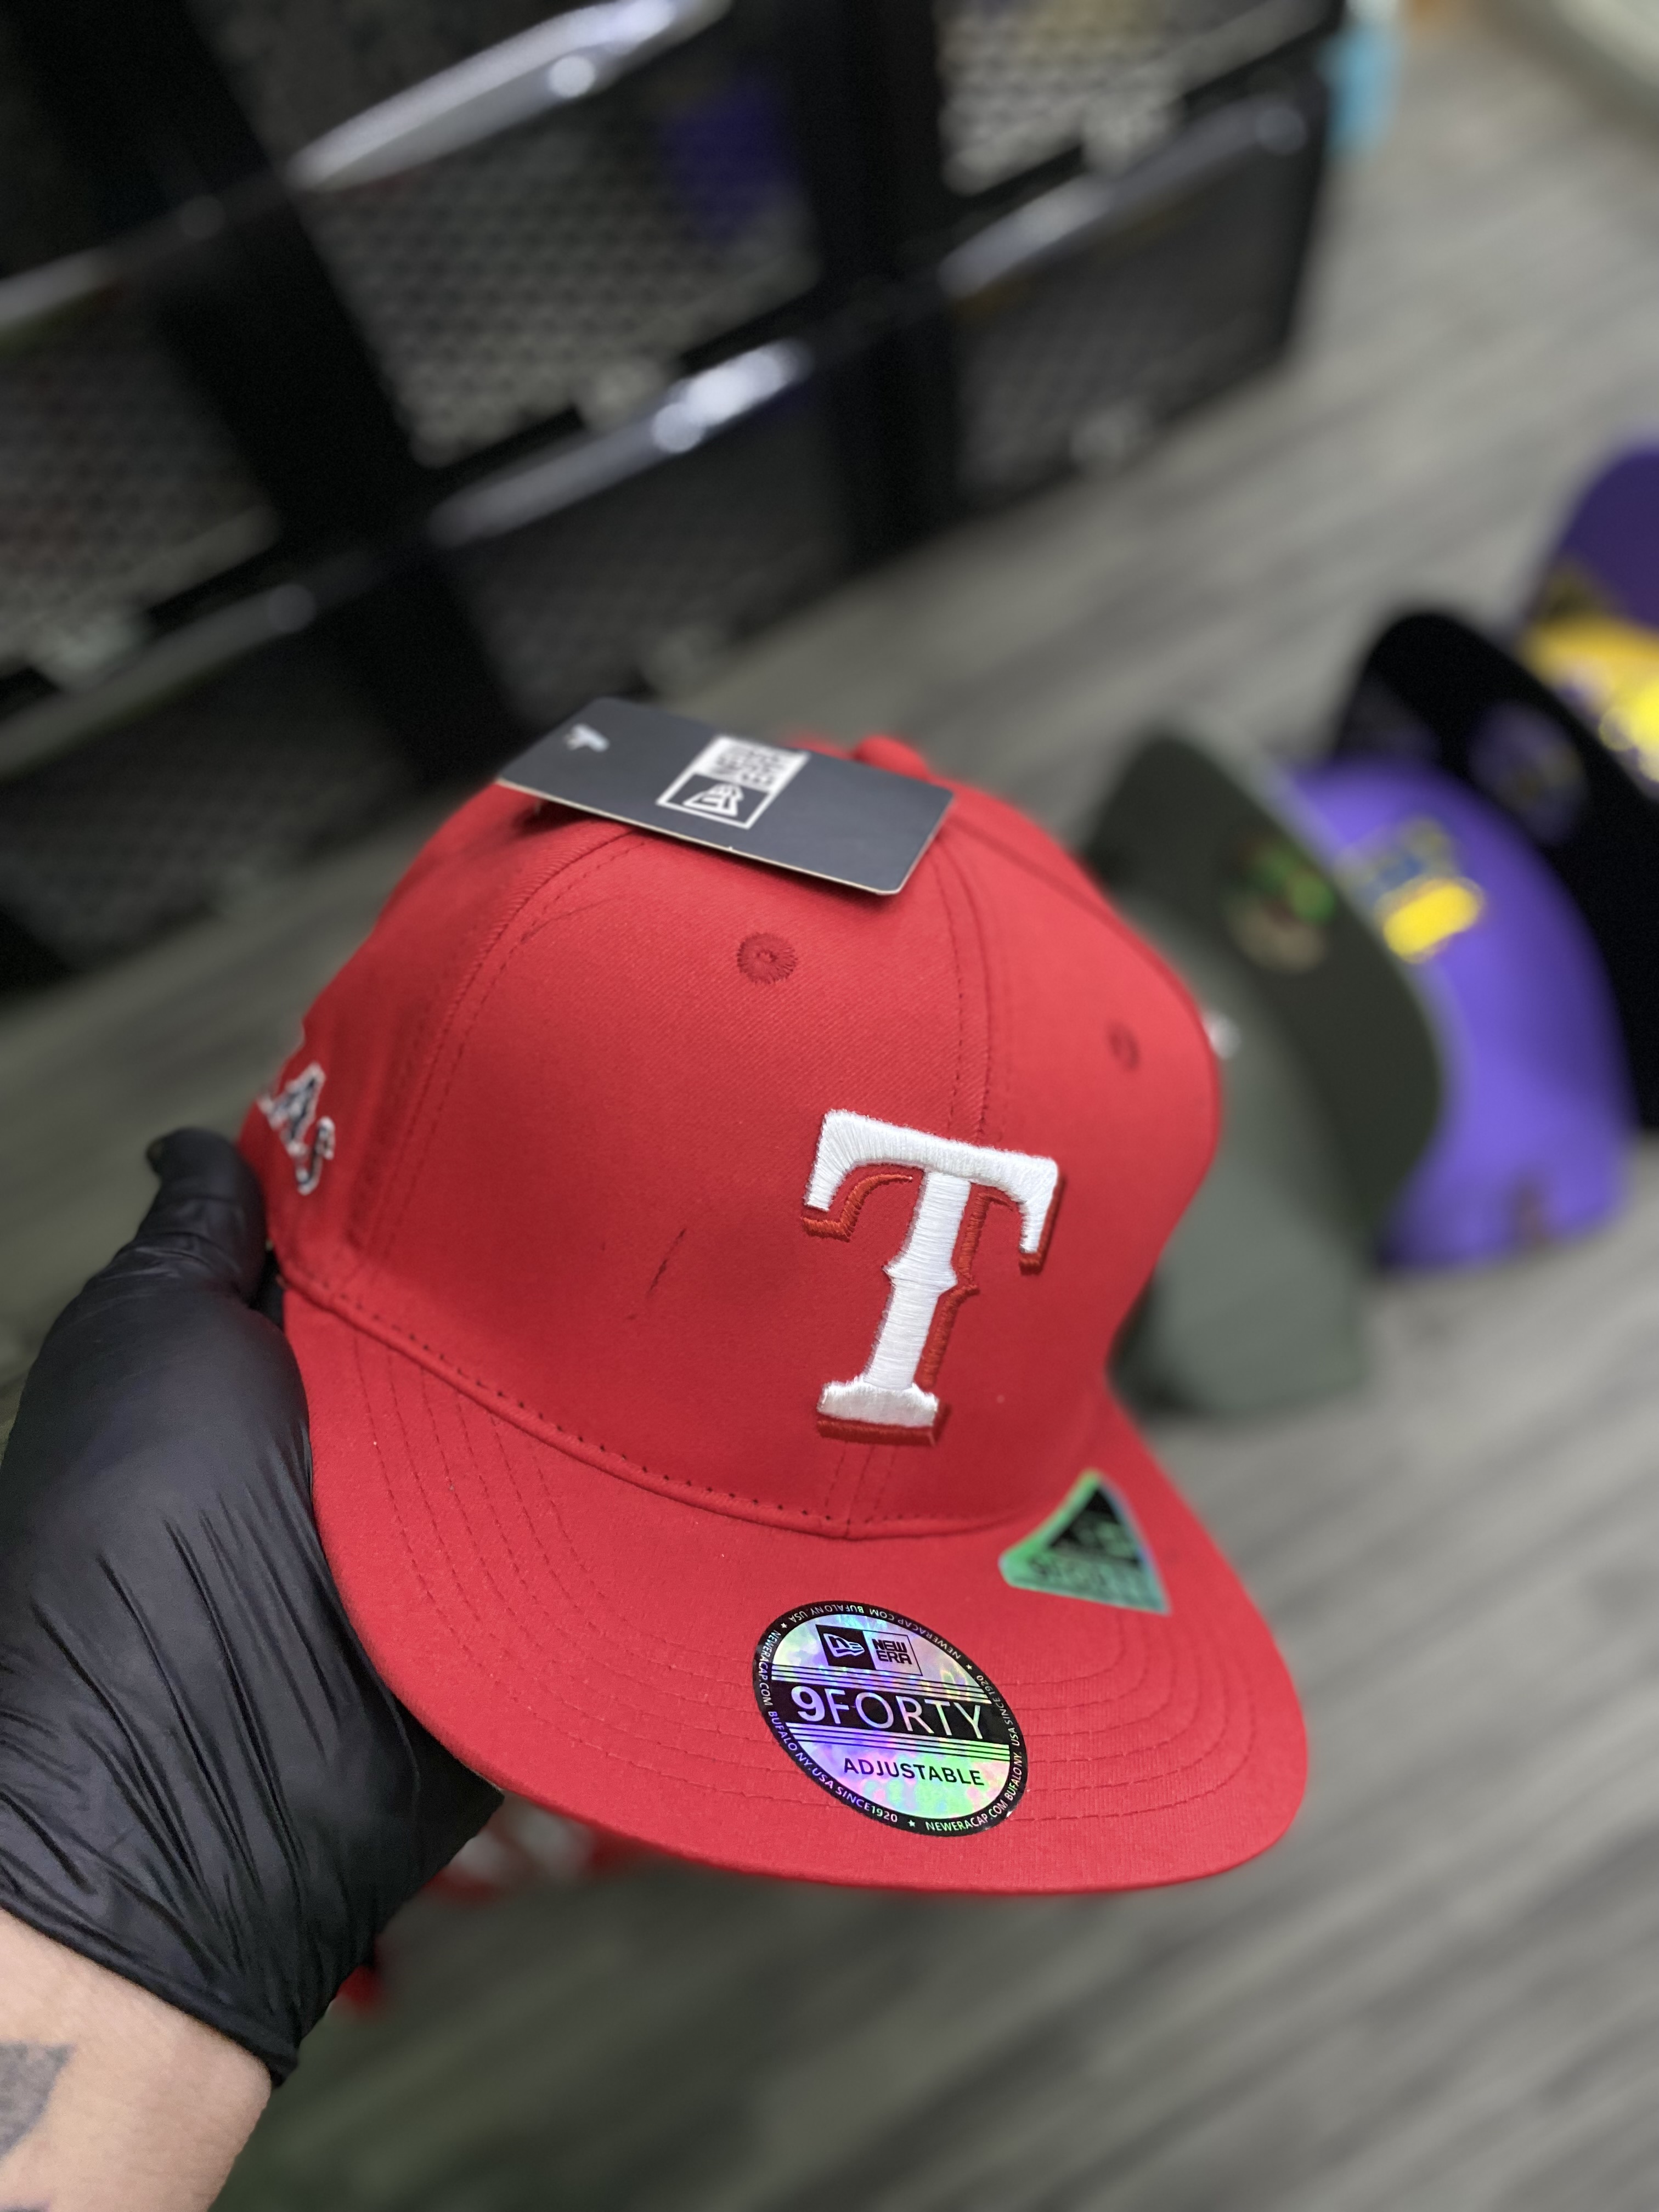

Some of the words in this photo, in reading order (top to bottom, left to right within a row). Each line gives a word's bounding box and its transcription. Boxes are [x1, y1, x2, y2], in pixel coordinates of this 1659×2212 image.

[802, 1107, 1065, 1446] T
[788, 1610, 808, 1623] USA
[872, 1638, 908, 1653] NEW
[876, 1650, 913, 1665] ERA
[758, 1629, 782, 1706] NEWERACAP.COM
[976, 1675, 996, 1695] 1920
[791, 1685, 984, 1739] 9FORTY
[992, 1697, 1014, 1725] SINCE
[1008, 1727, 1020, 1747] USA
[844, 1758, 985, 1786] ADJUSTABLE
[925, 1799, 1008, 1832] NEWERACAP.COM
